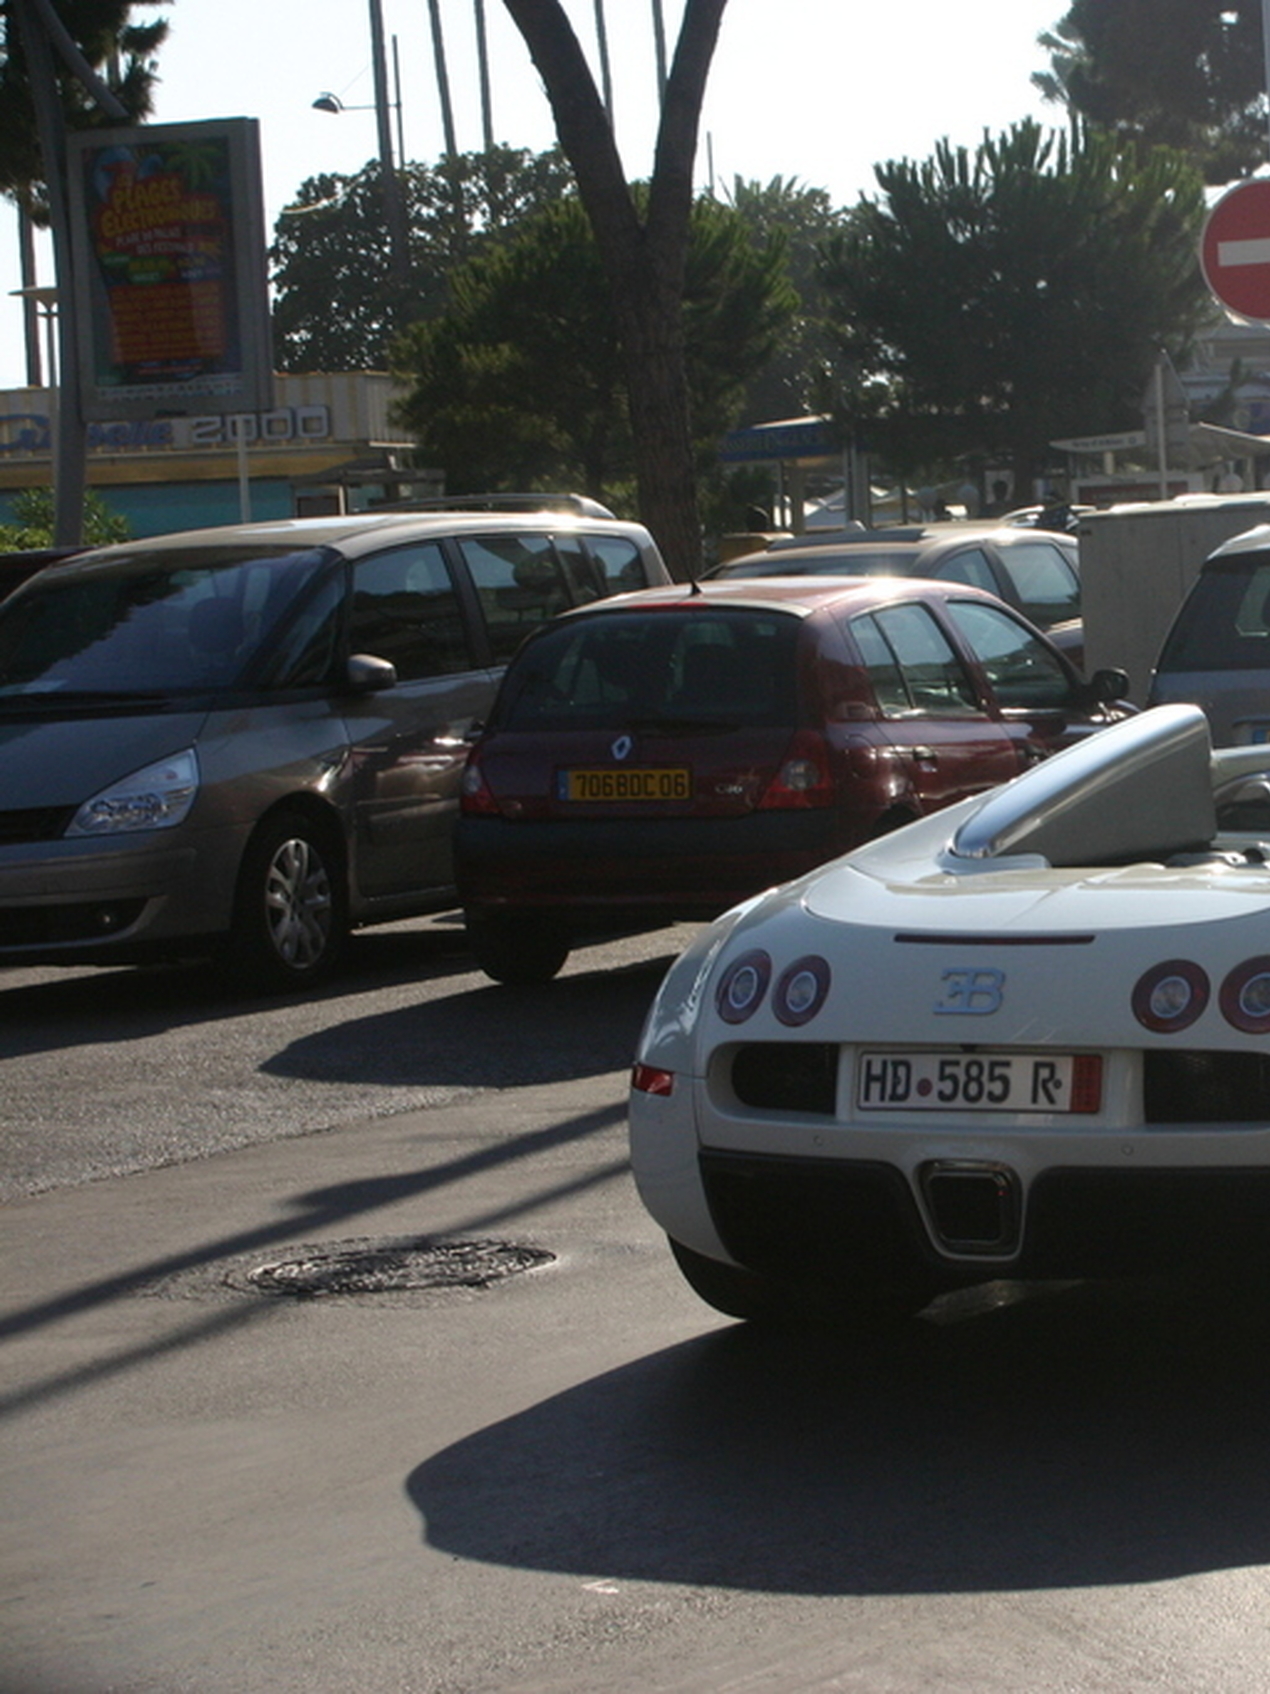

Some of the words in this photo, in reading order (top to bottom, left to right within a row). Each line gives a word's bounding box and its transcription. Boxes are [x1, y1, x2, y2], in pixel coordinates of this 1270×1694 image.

[112, 177, 181, 212] PLAGES
[191, 405, 330, 443] 2000
[863, 1059, 912, 1103] HD
[937, 1059, 1012, 1104] 585
[1031, 1061, 1058, 1105] R
